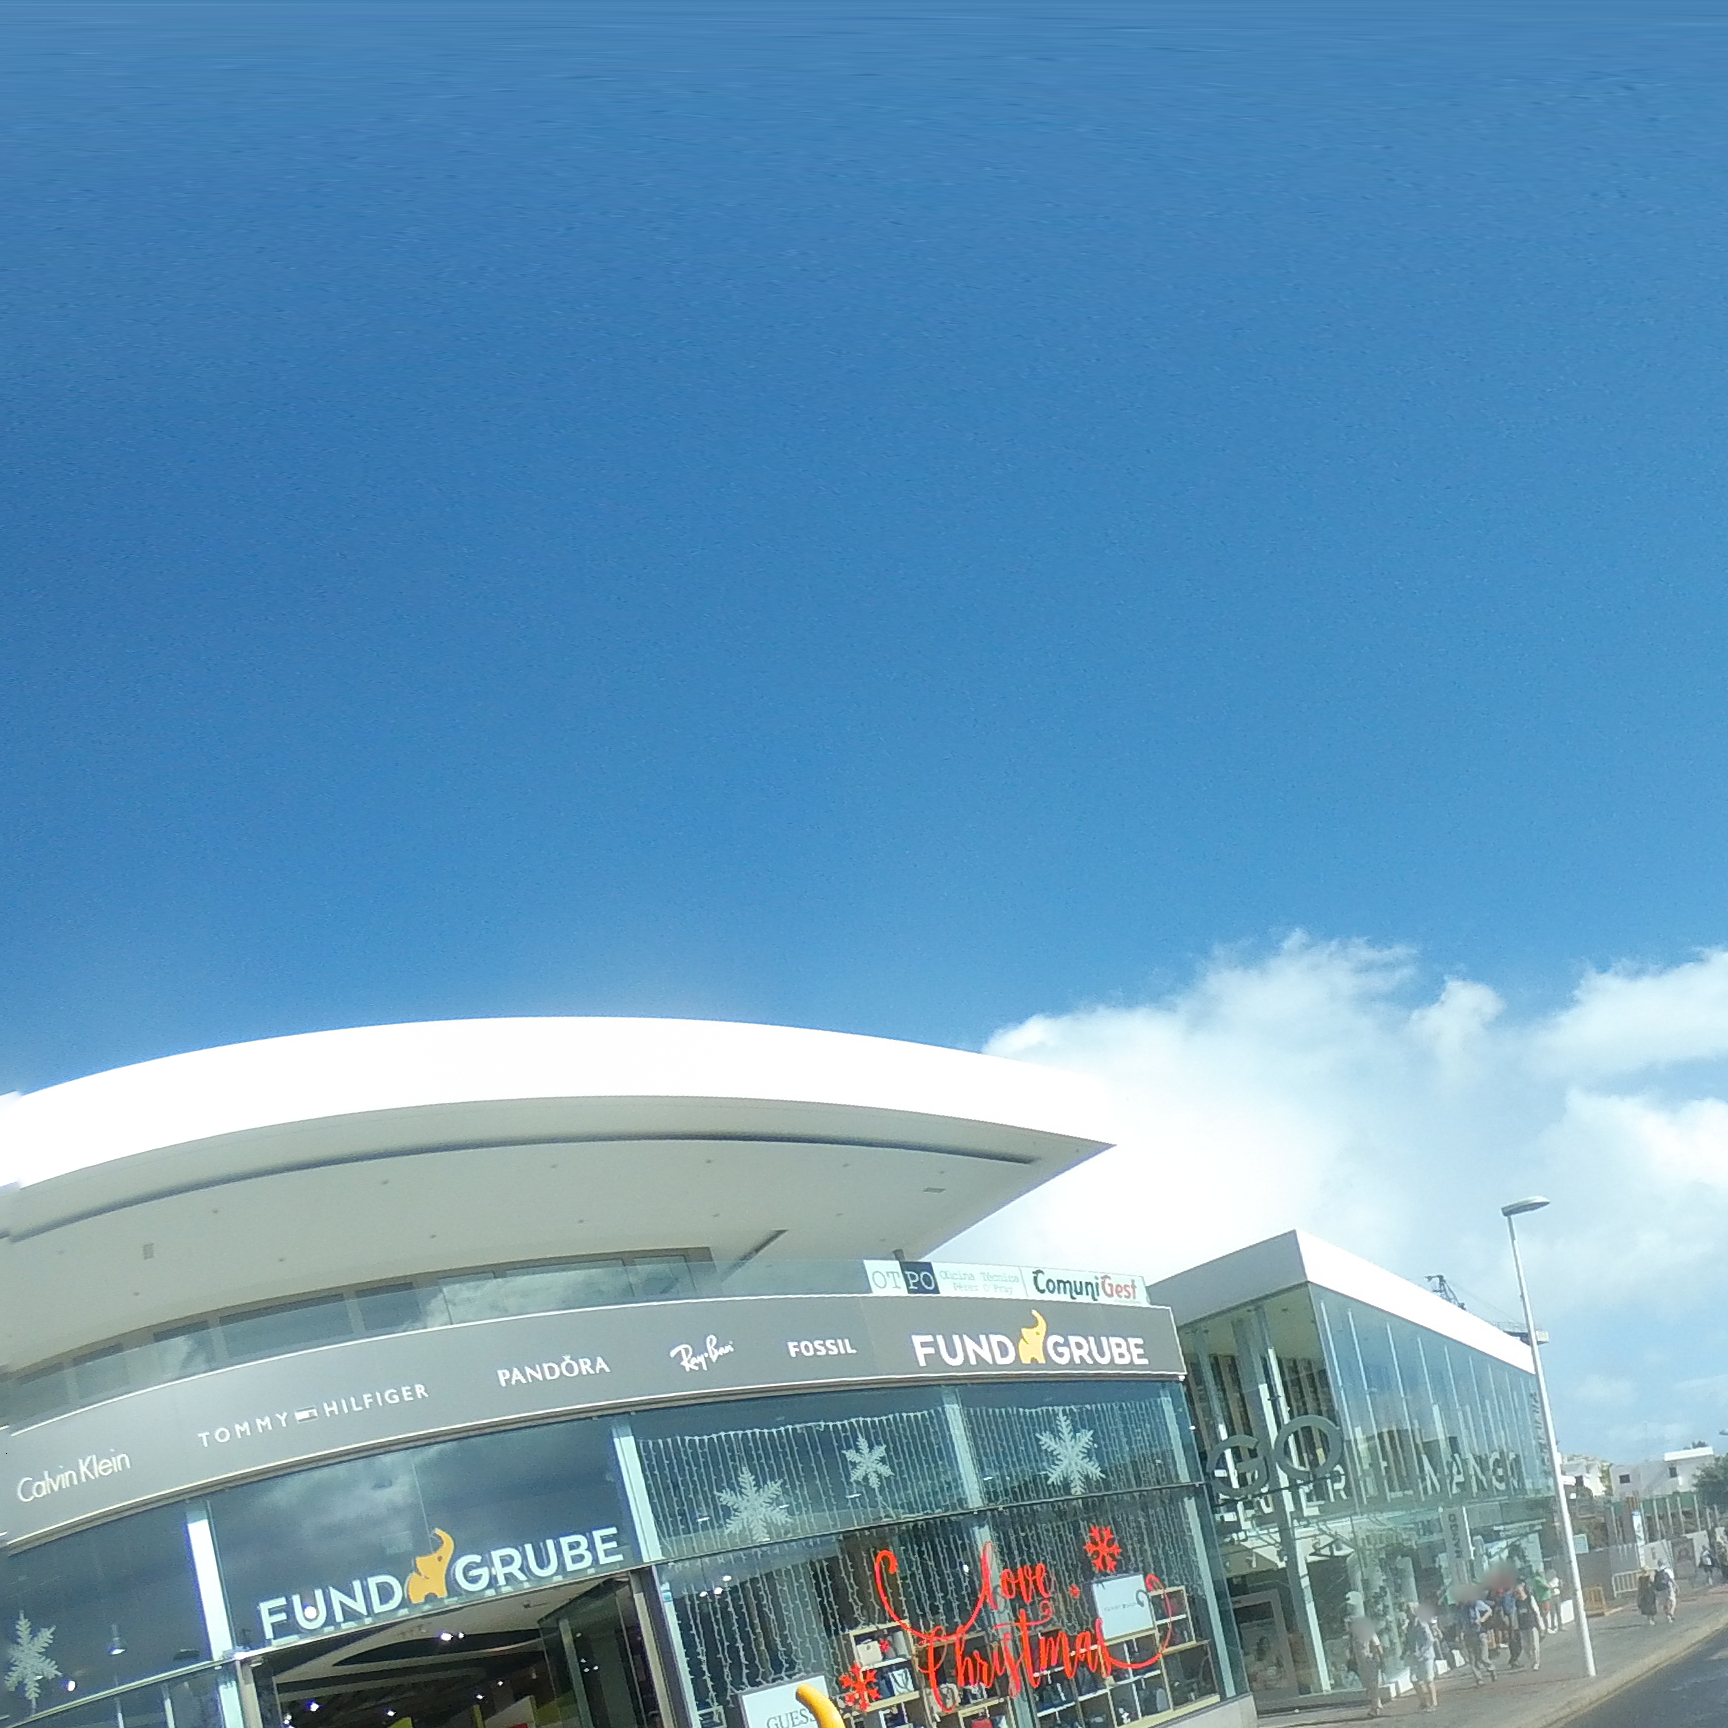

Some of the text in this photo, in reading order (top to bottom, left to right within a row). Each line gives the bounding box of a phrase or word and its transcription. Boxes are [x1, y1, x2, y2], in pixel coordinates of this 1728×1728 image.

[787, 1338, 857, 1358] FOSSIL
[912, 1334, 1149, 1367] FUND GRUBE
[198, 1384, 430, 1448] TOMMY HILFIGER
[17, 1448, 131, 1503] Calvin Klein
[258, 1526, 624, 1640] FUND GRUBE
